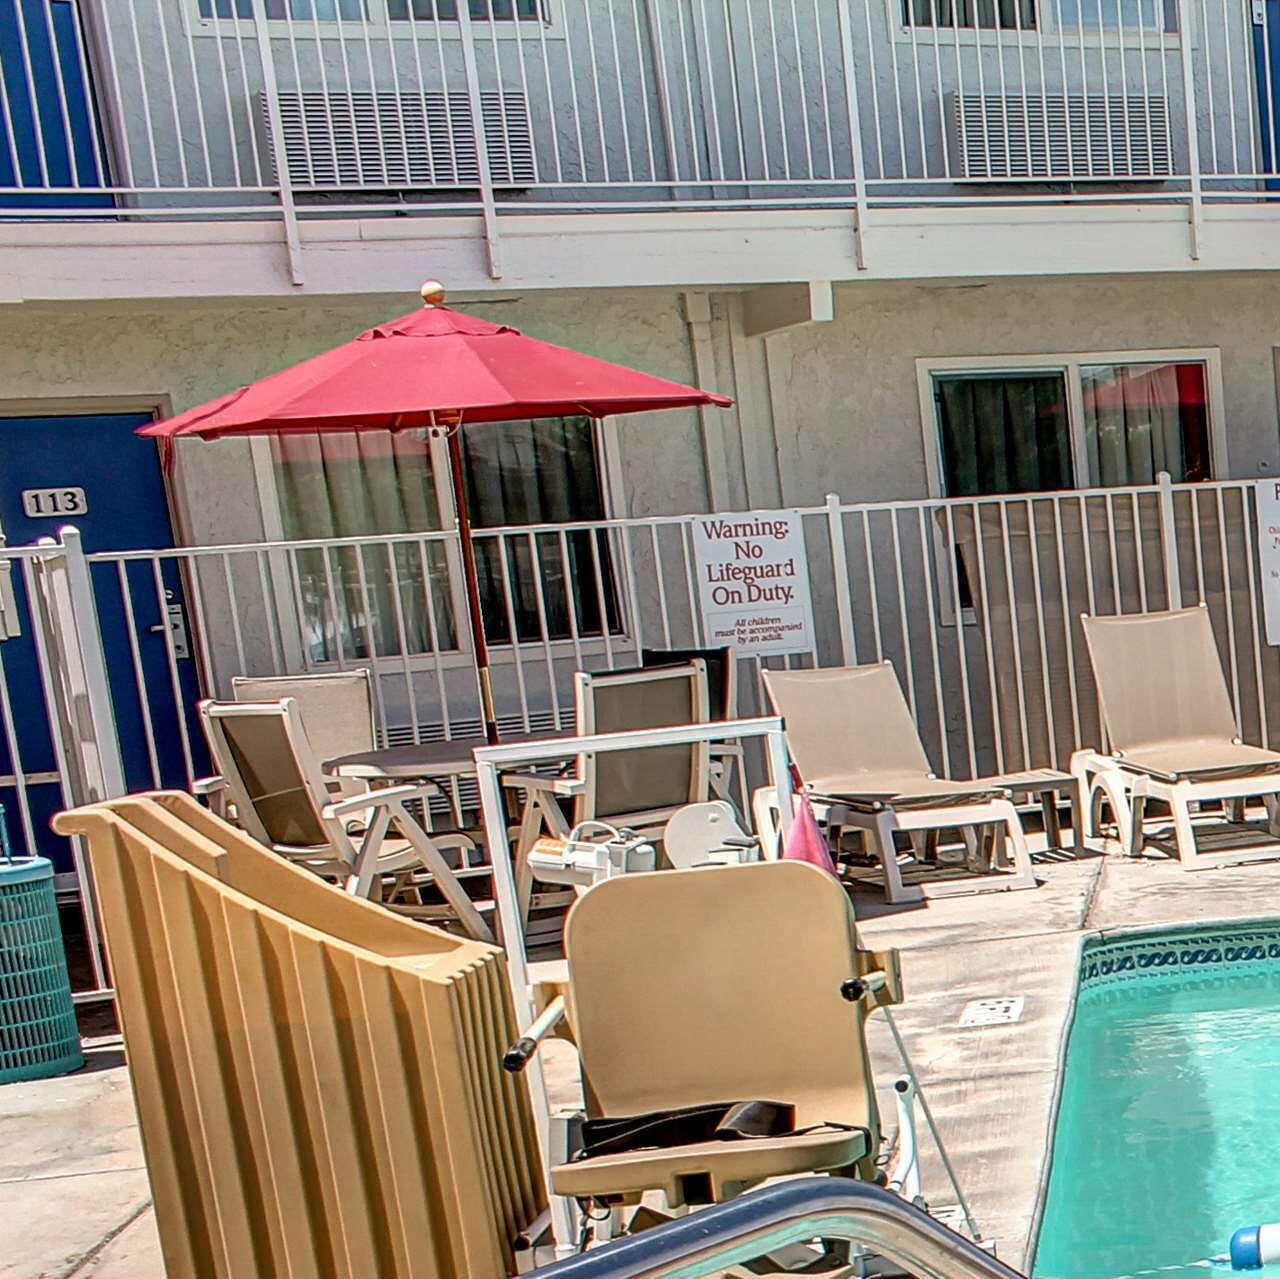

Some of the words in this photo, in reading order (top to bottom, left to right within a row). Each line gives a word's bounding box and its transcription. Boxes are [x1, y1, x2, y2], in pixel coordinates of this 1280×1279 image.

[31, 491, 80, 513] 113
[702, 517, 790, 540] Warning:
[733, 540, 763, 560] No
[706, 558, 796, 584] Lifeguard
[712, 586, 743, 605] On
[747, 583, 794, 605] Duty.
[735, 618, 747, 627] All
[747, 616, 781, 627] children
